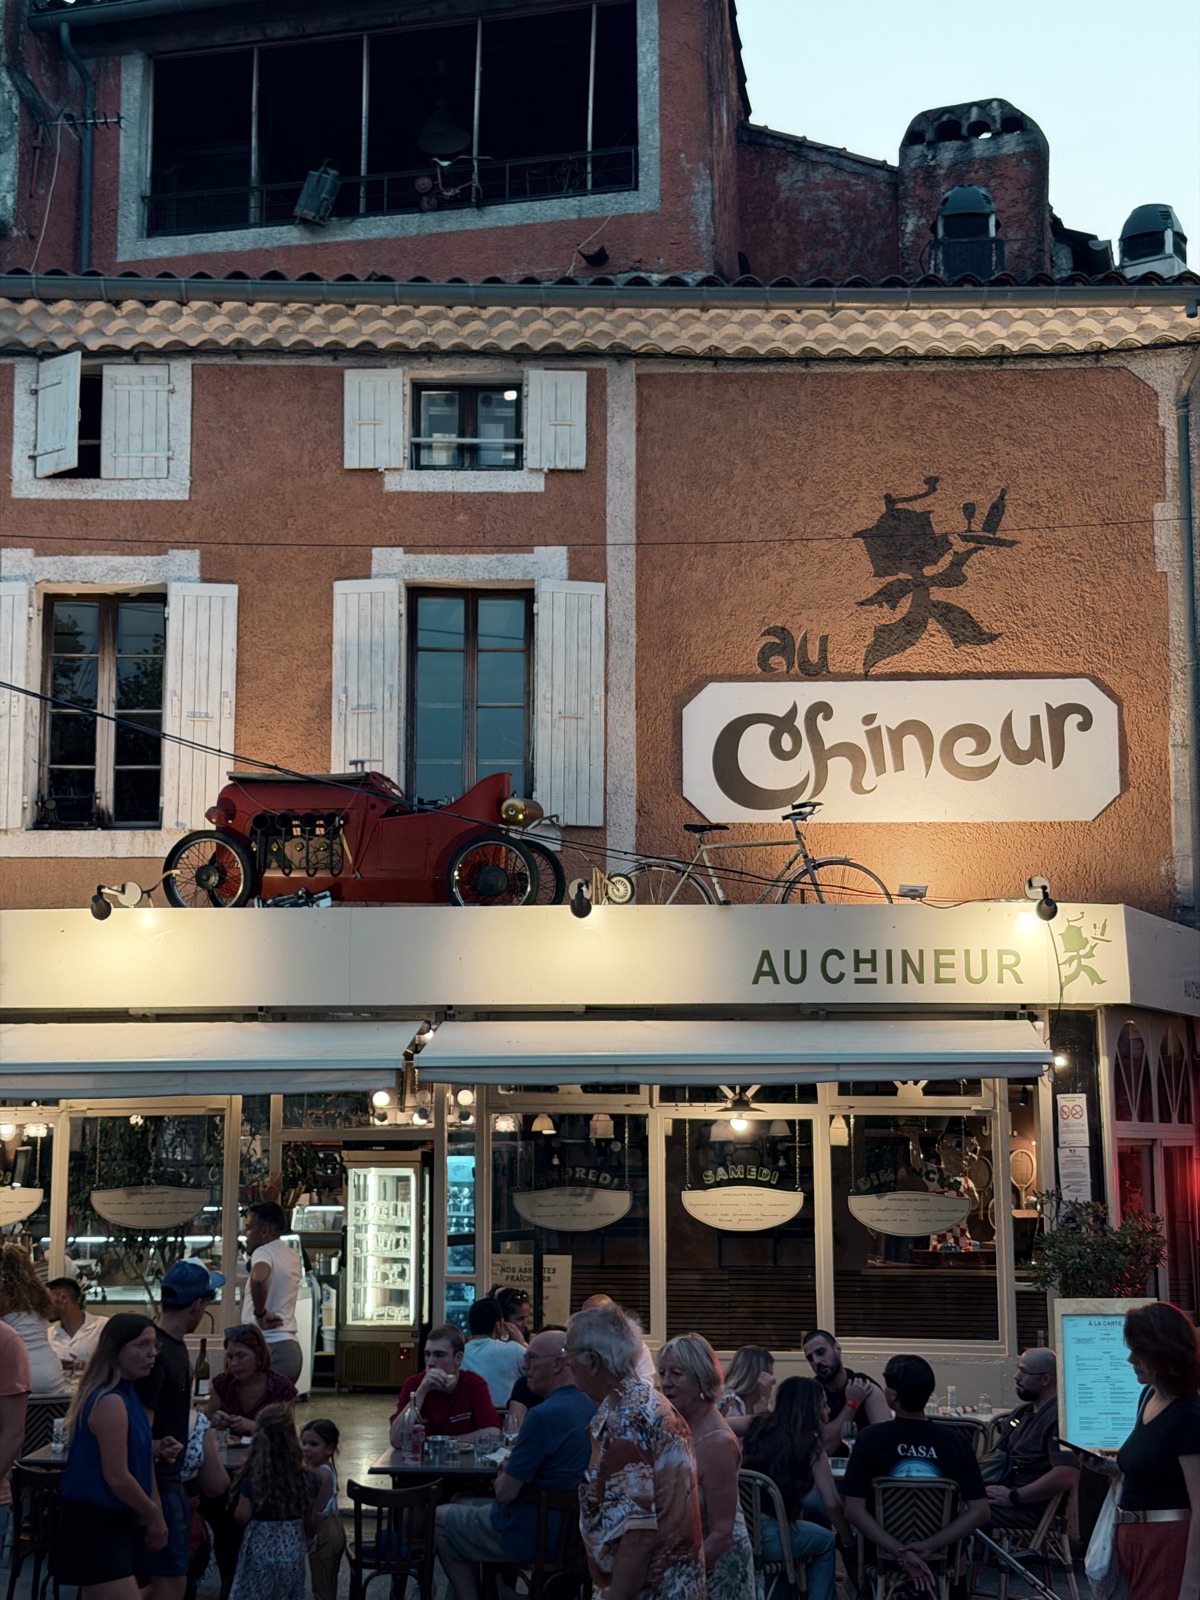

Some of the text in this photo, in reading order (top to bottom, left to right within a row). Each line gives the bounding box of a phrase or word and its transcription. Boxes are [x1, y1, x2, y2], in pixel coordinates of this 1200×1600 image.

[757, 625, 830, 677] au
[712, 701, 1093, 810] Chineur
[751, 948, 1024, 986] AU CHINEUR
[702, 1164, 780, 1184] SAMEDI
[501, 1266, 517, 1274] NOS
[518, 1266, 557, 1275] ASSTES
[897, 1443, 938, 1459] CASA
